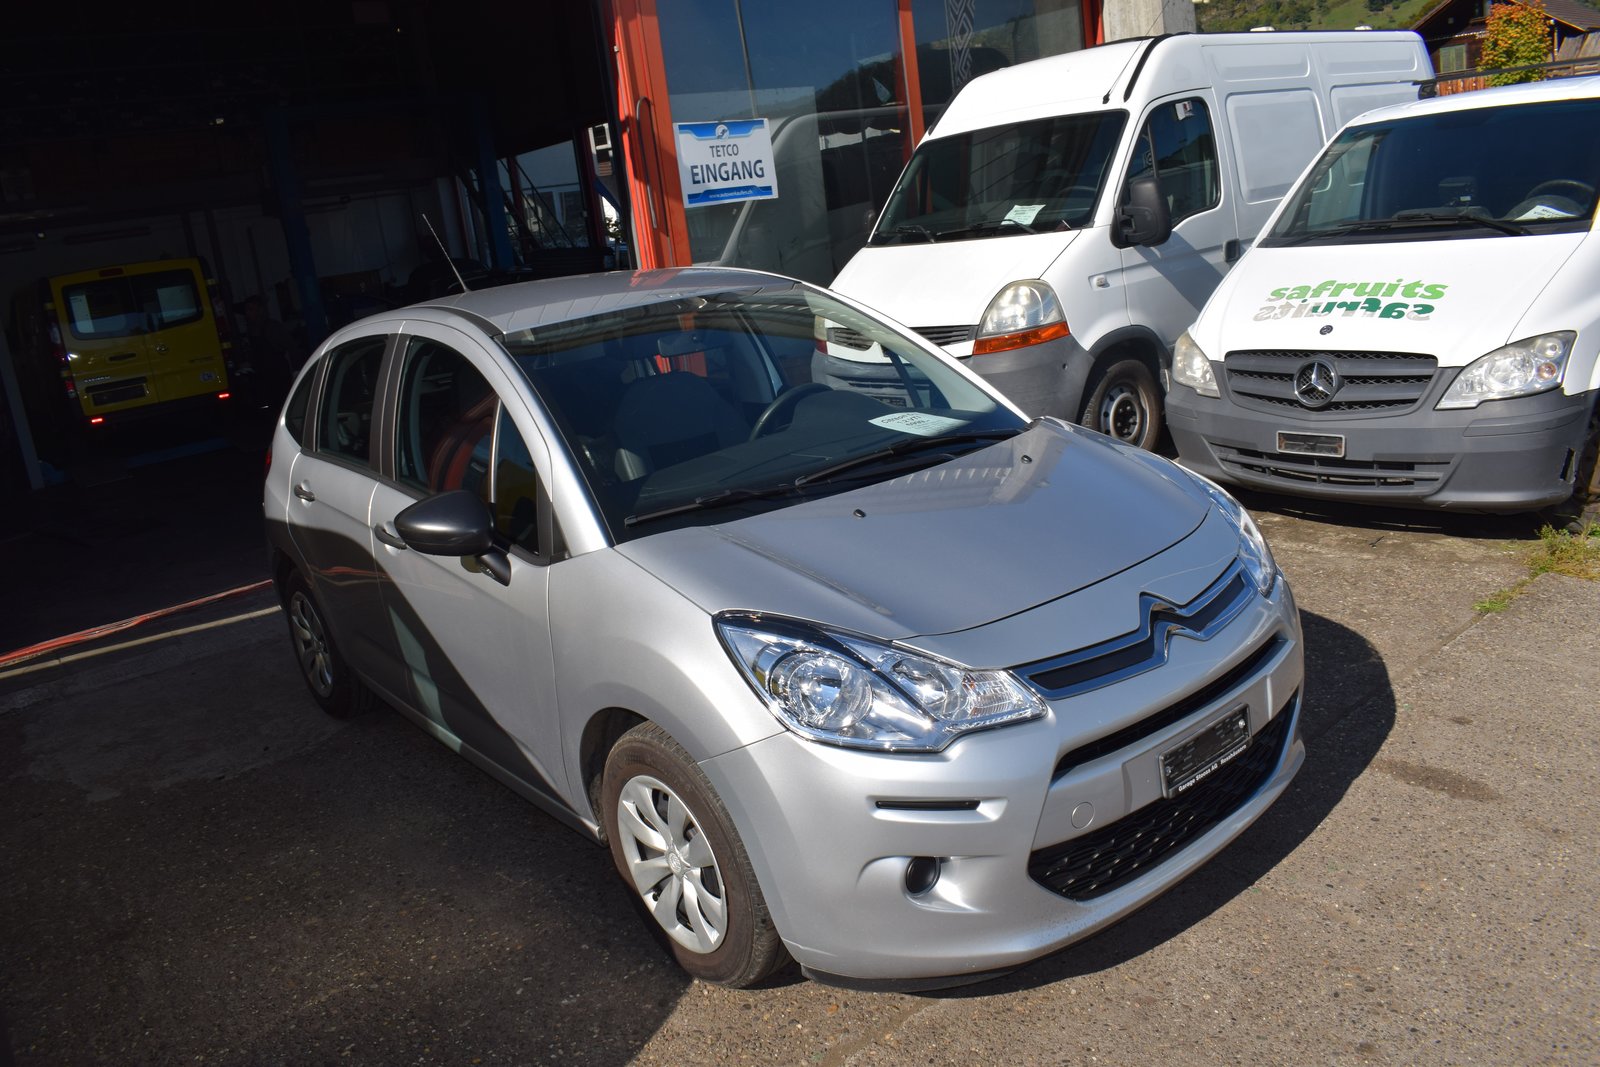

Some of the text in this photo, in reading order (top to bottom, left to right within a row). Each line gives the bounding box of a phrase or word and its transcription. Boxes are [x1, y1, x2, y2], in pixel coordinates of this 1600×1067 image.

[709, 144, 739, 158] TETCO
[690, 159, 765, 185] EINGANG
[1265, 278, 1449, 302] safruits
[1178, 778, 1196, 792] Garage
[1211, 763, 1218, 771] AG
